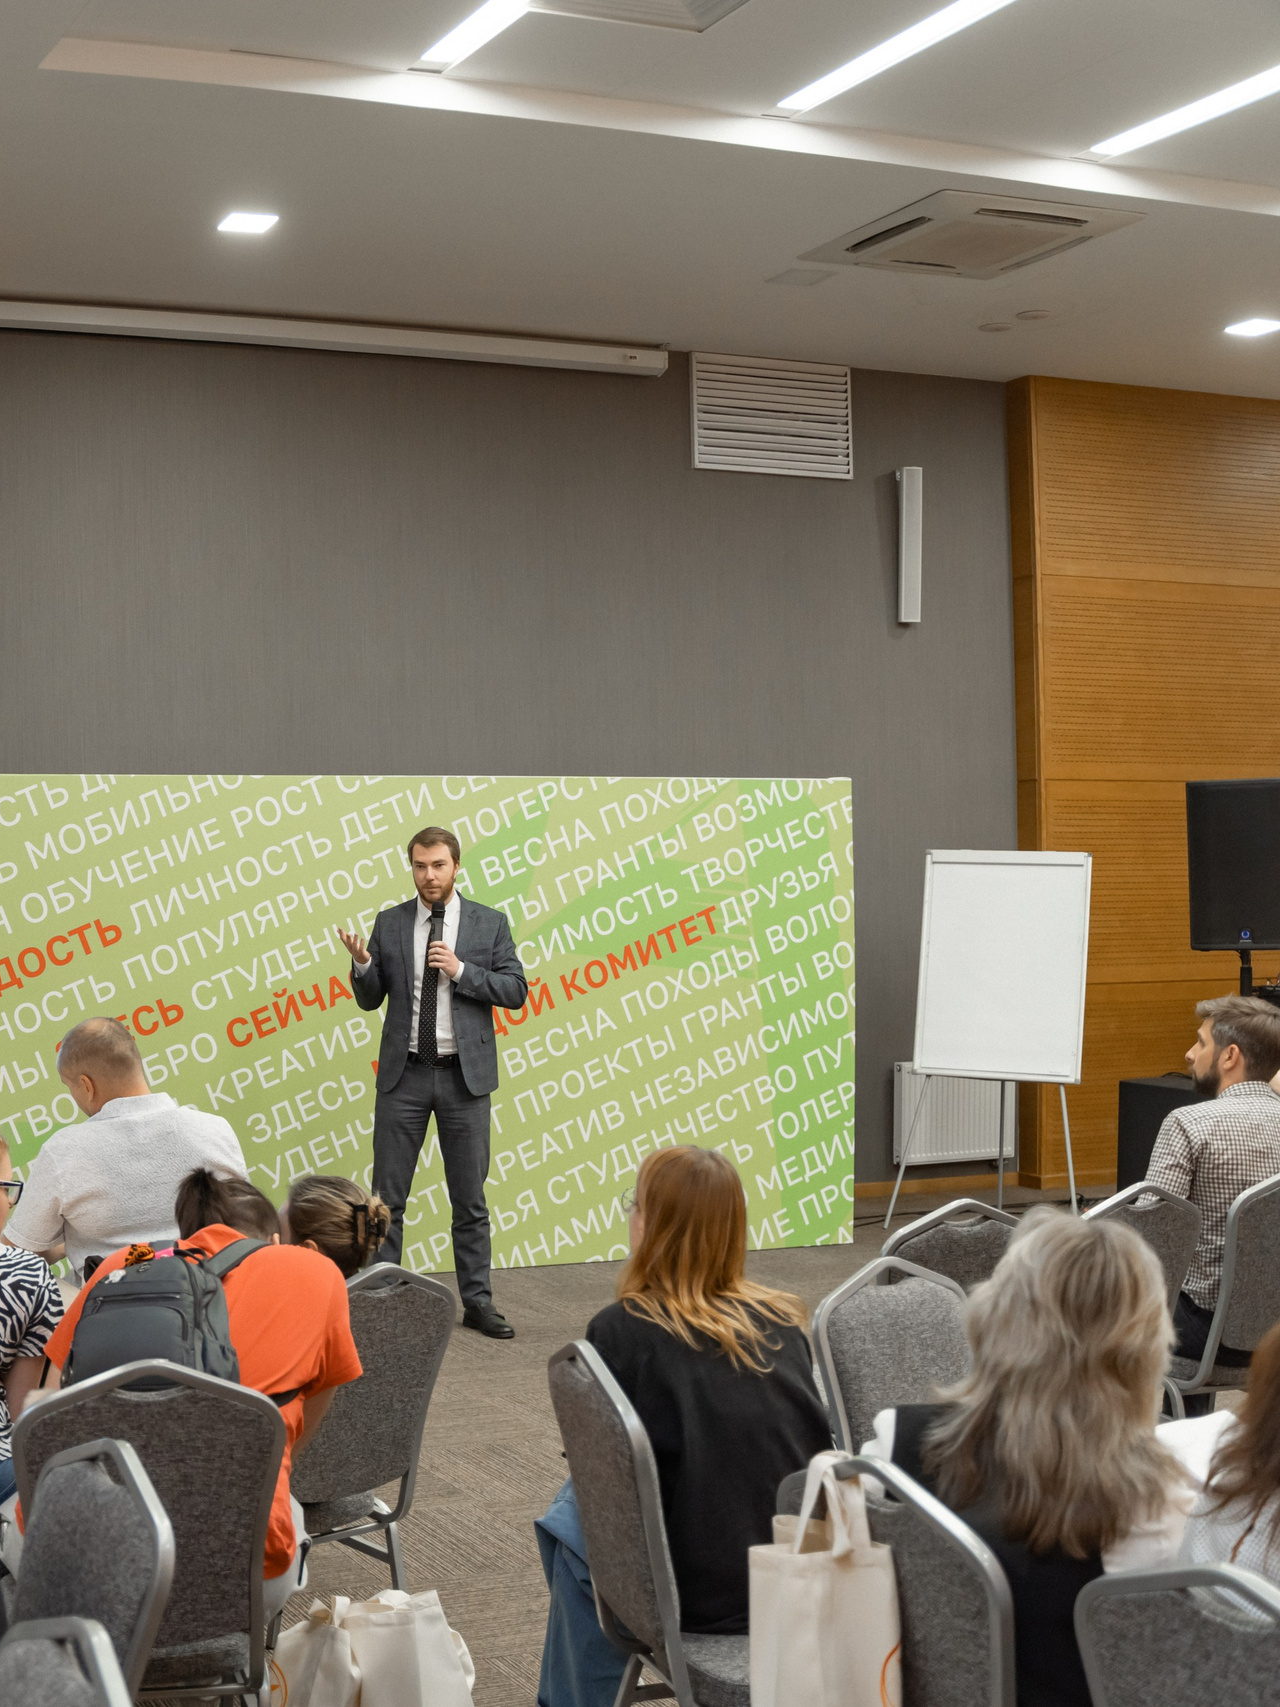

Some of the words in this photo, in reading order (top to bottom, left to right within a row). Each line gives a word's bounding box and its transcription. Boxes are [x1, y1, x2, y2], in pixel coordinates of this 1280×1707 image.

[20, 818, 226, 923] ОБУЧЕНИЕ
[230, 776, 323, 838] РОСТ
[129, 831, 332, 935] ЛИЧНОСТЬ
[340, 783, 435, 852] ДЕТИ
[480, 818, 596, 887] ВЕСНА
[226, 970, 353, 1048] СЕЙЧА
[491, 885, 550, 928] ТЫ
[555, 824, 687, 904] ГРАНТЫ
[246, 1074, 366, 1143] ЗДЕСЬ
[559, 905, 717, 1001] КОМИТЕТ
[720, 851, 840, 934] ДРУЗЬЯ
[502, 1007, 618, 1079] ВЕСНА
[620, 936, 761, 1024] ПОХОДЫ
[765, 889, 855, 955] ВОЛО
[205, 1016, 372, 1110] КРЕАТИВ
[513, 1025, 677, 1123] ПРОЕКТЫ
[681, 962, 808, 1043] ГРАНТЫ
[483, 1099, 625, 1187] РЕАТИВ
[547, 1065, 797, 1204] СТУДЕНЧЕСТВО
